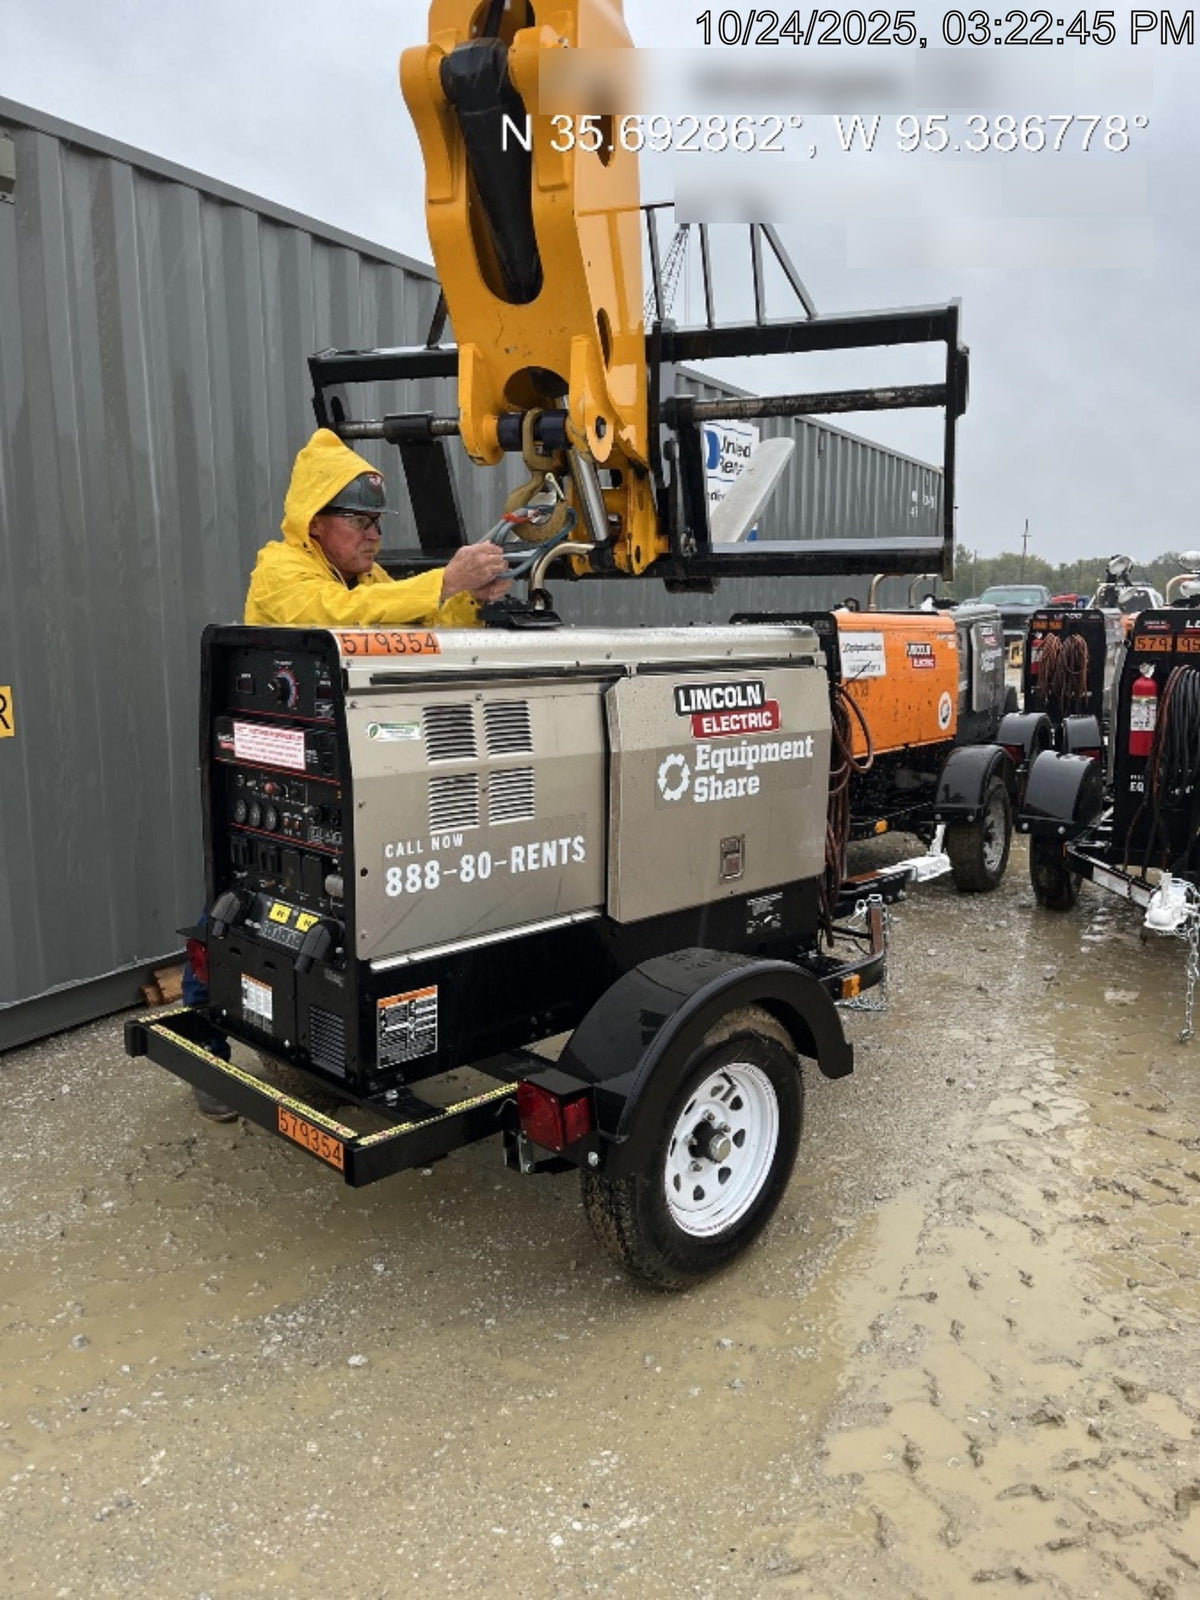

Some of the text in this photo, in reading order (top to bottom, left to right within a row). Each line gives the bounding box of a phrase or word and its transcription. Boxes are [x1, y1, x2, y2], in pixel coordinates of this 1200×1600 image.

[341, 632, 440, 656] 579354
[678, 682, 764, 713] LINCOLN
[702, 712, 773, 734] ELECTRIC
[694, 735, 814, 774] Equipment
[693, 773, 760, 803] Share
[385, 833, 464, 859] CALL NOW
[385, 835, 586, 897] 888-80-RENTS
[280, 1108, 343, 1165] 579354
